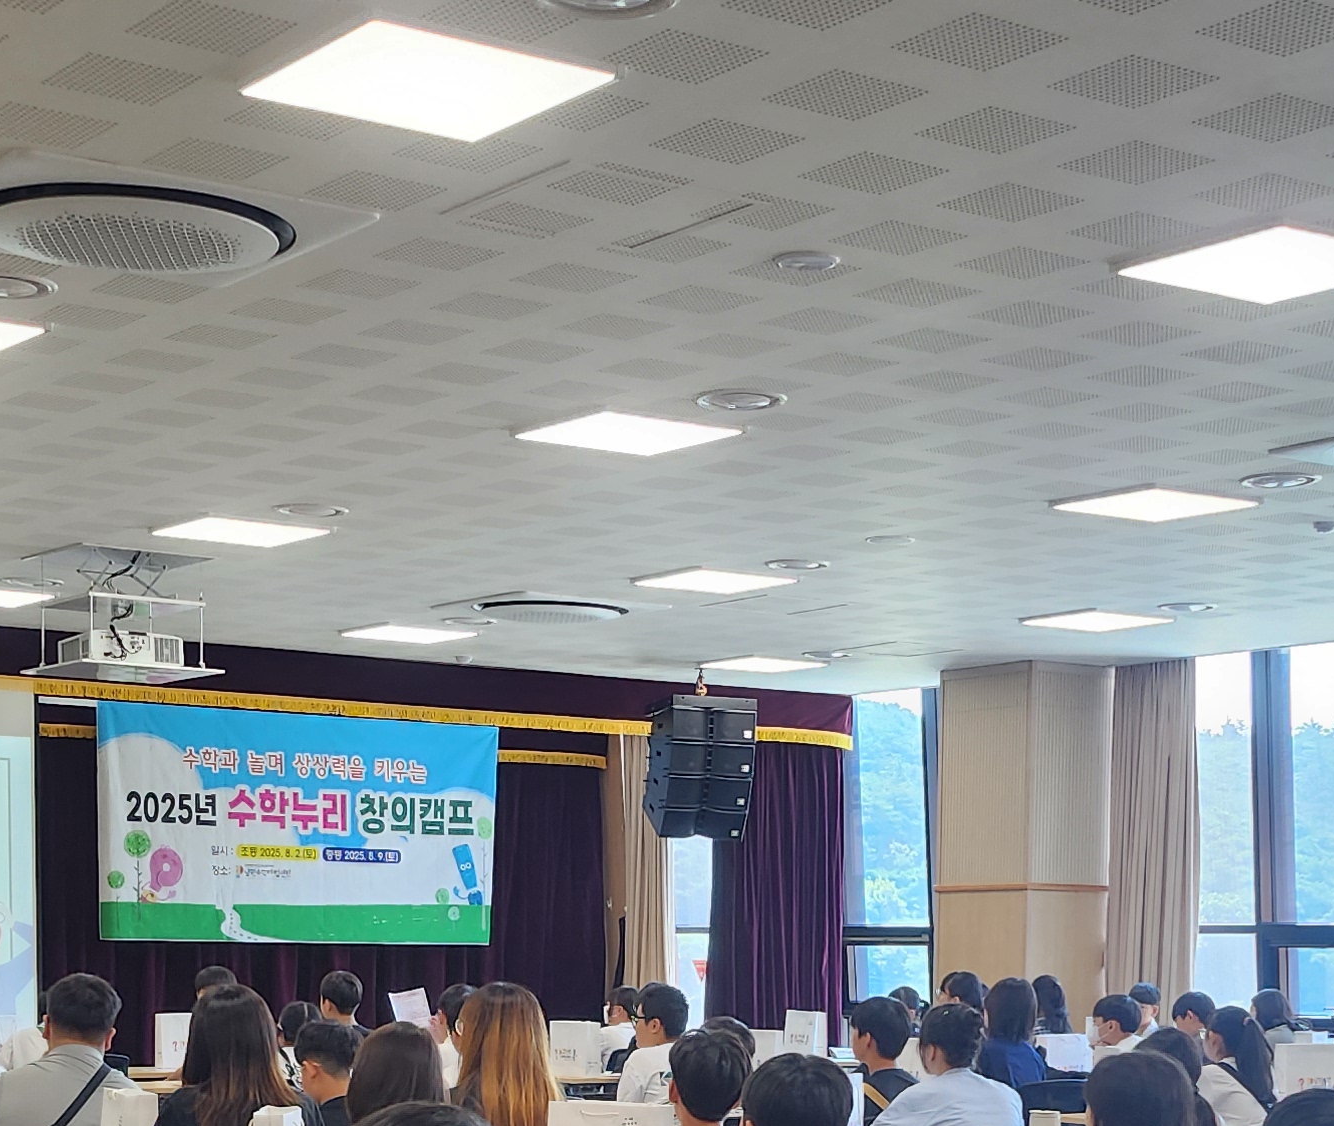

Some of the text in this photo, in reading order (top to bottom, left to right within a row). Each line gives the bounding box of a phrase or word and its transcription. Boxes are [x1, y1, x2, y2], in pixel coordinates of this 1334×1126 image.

[183, 748, 428, 783] 수학과 늘며 상상력을 키우는
[126, 789, 475, 835] 2025년 수학누리 창의캠프
